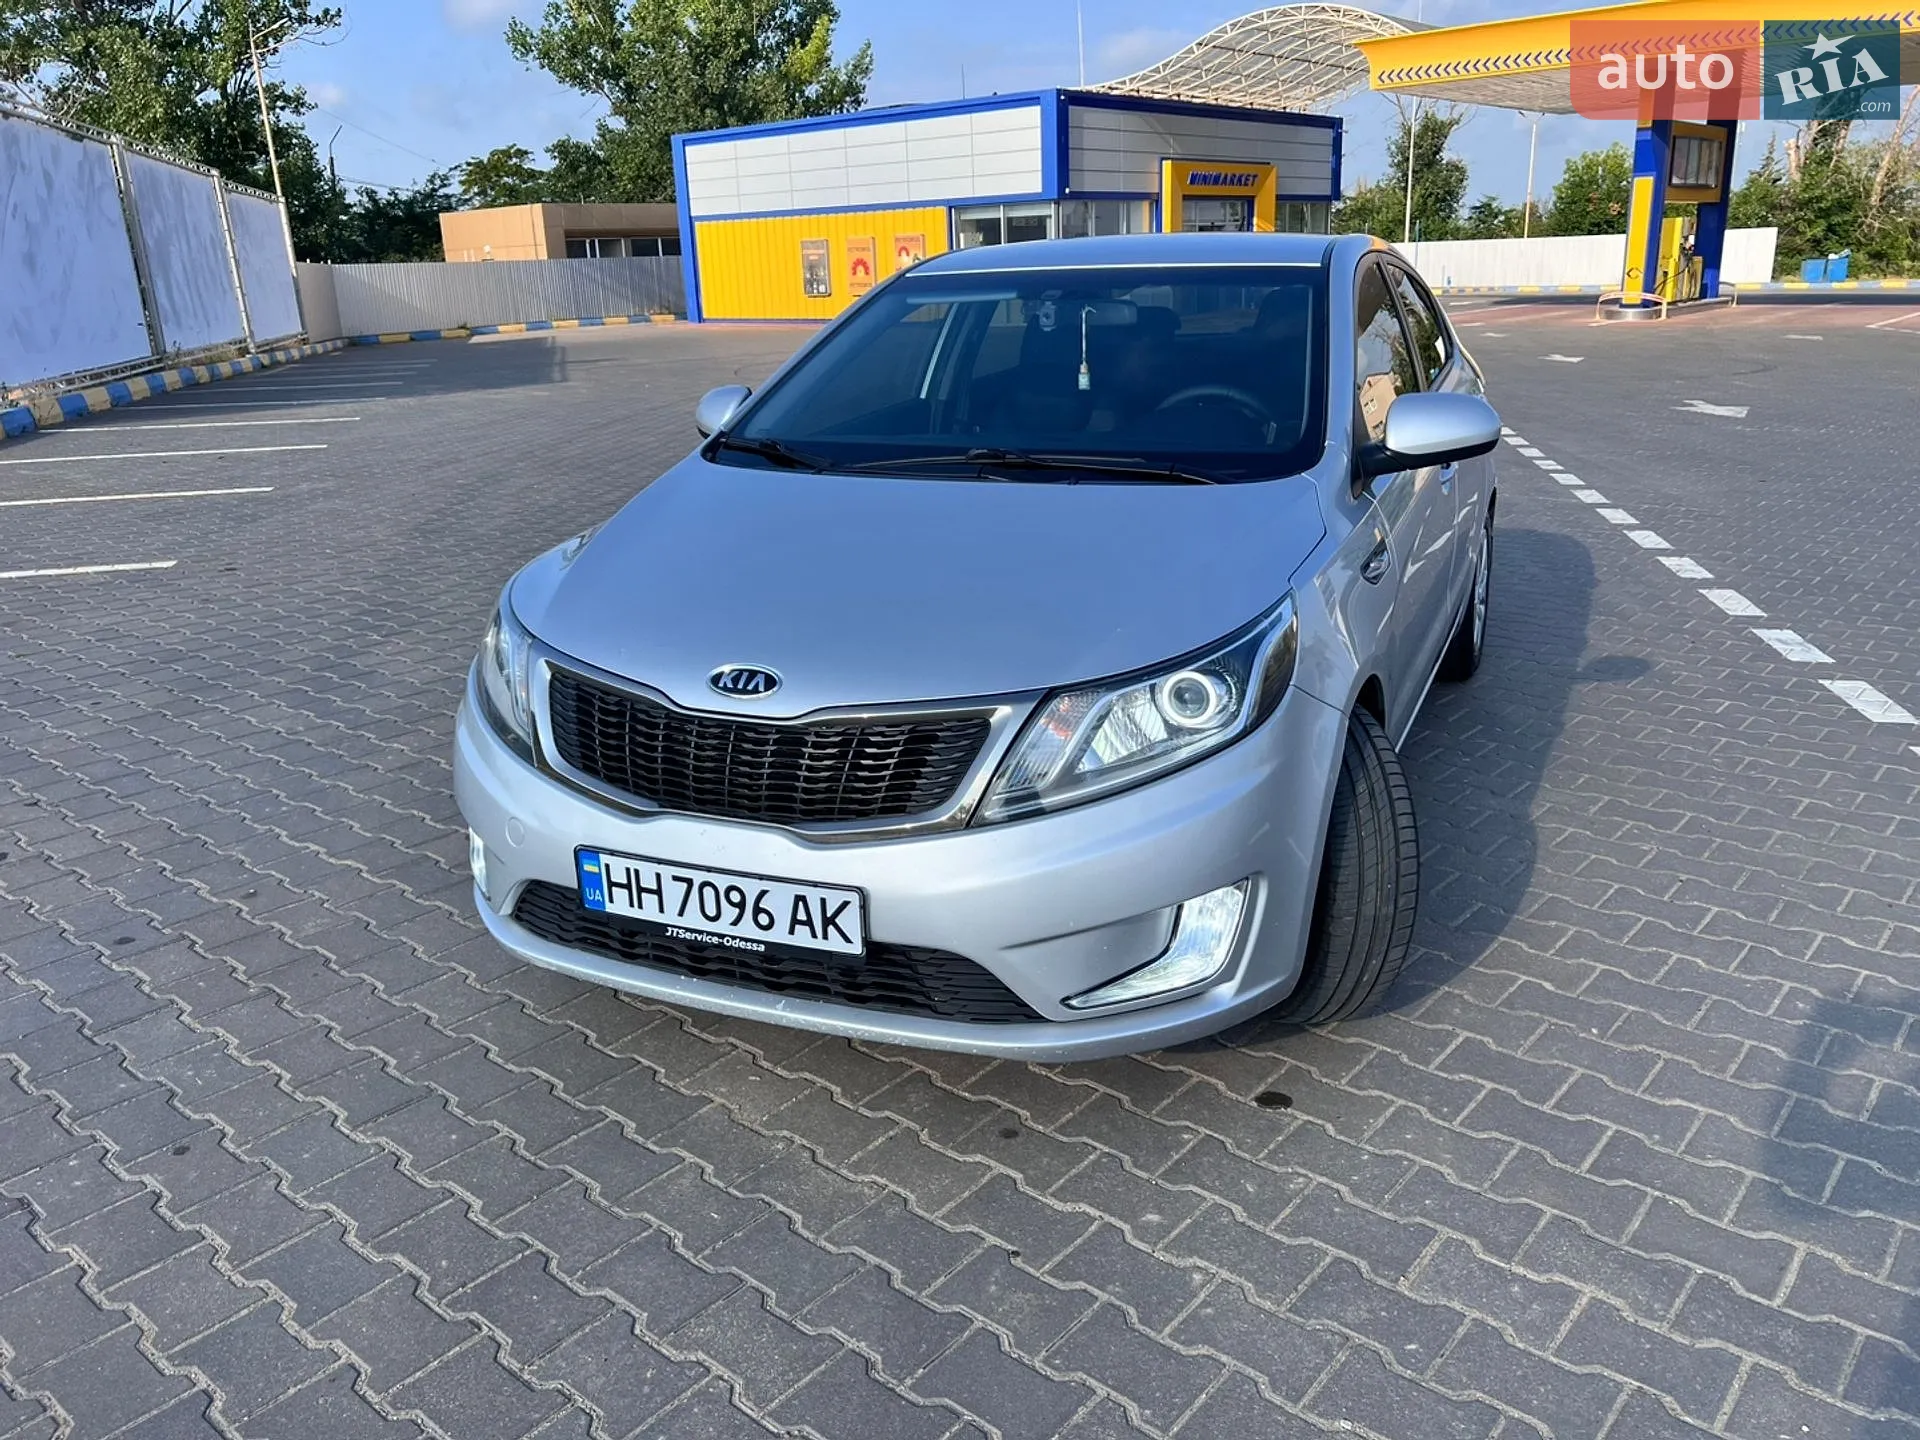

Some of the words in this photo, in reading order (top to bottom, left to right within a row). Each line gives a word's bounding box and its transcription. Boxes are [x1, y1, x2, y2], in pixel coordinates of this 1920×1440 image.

[1187, 171, 1258, 187] MINIMARKET
[718, 671, 765, 692] KIA
[585, 887, 602, 902] UA
[604, 863, 665, 914] HH
[671, 875, 775, 931] 7096
[788, 894, 853, 944] AK
